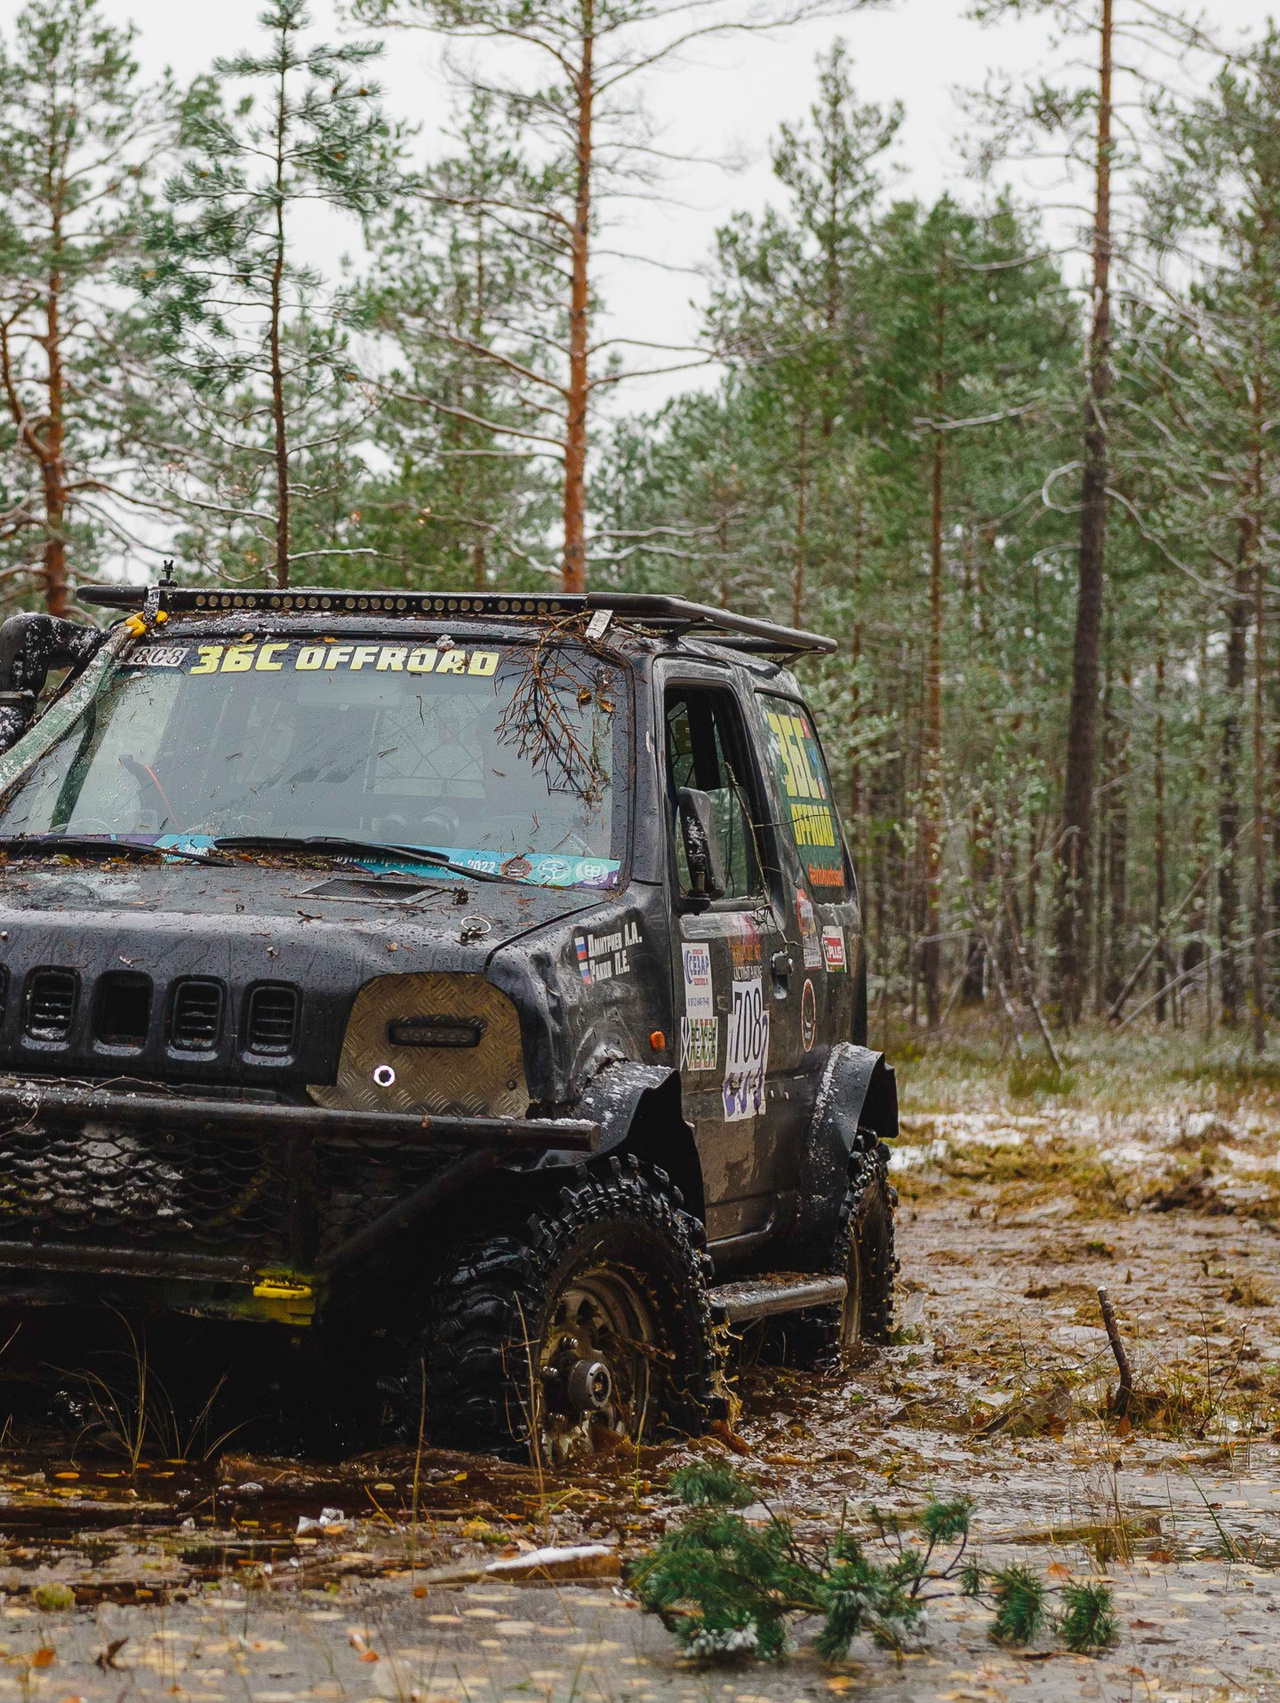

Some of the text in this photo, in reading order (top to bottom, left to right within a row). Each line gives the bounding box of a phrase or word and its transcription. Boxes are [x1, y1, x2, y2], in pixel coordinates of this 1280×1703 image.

[294, 645, 500, 677] OFFROAD
[790, 803, 835, 847] OFFROAD
[734, 986, 762, 1064] 708
